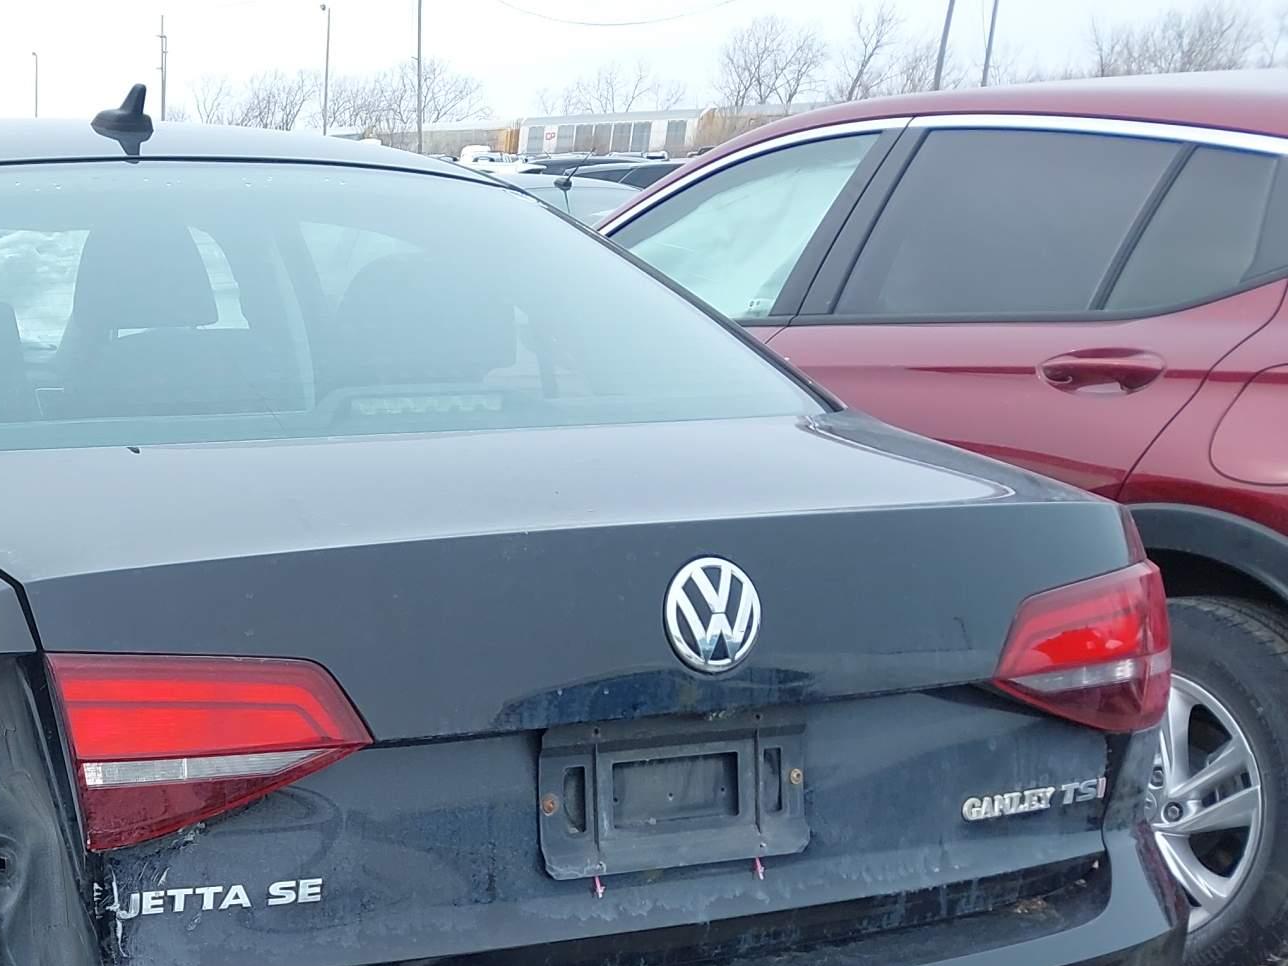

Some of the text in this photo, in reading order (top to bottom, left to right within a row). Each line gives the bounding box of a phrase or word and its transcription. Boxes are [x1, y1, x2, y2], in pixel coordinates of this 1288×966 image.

[962, 777, 1107, 821] GANLEY TSI
[116, 878, 323, 920] JETTA SE
